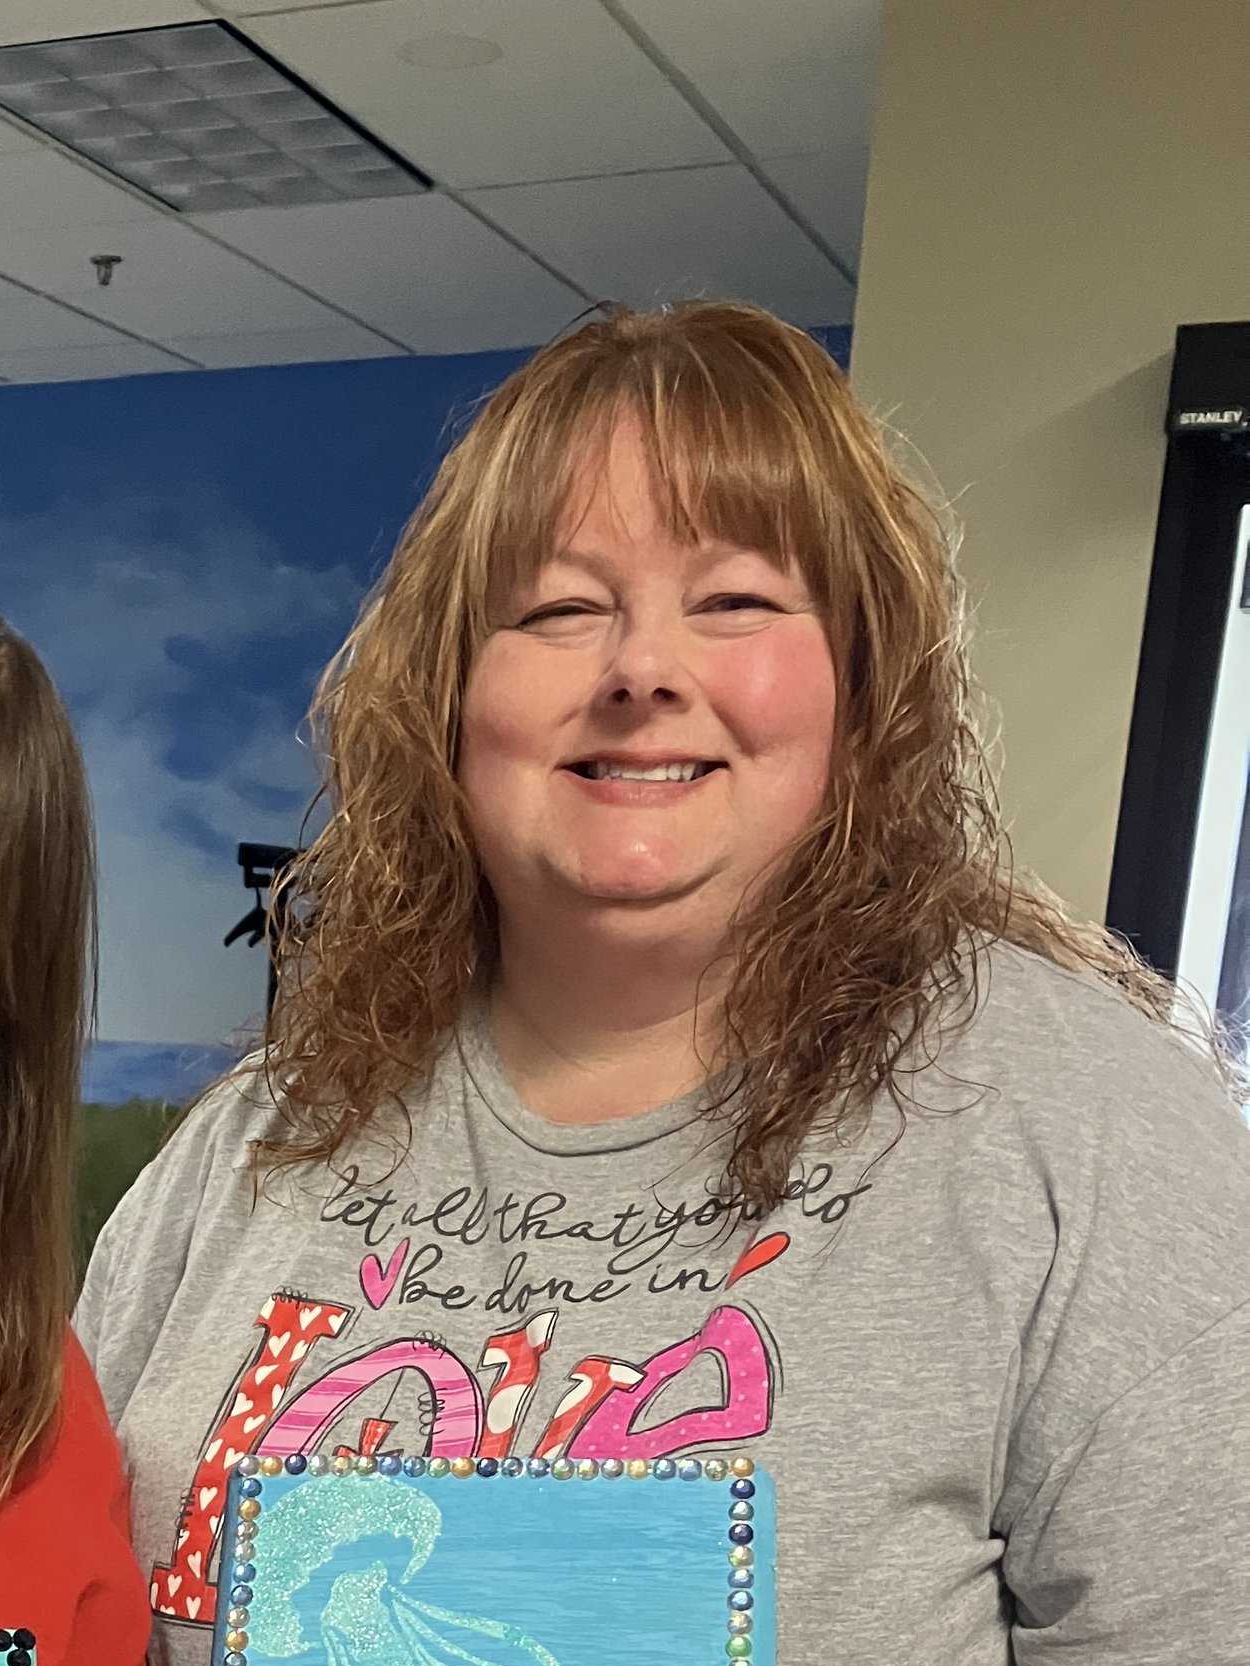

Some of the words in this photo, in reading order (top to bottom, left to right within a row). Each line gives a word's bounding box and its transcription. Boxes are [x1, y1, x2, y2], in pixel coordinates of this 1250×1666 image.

[1180, 411, 1242, 425] STANLEY
[401, 1186, 490, 1245] all
[493, 1191, 647, 1247] that
[399, 1243, 478, 1310] be
[485, 1251, 632, 1313] done
[649, 1263, 728, 1294] in
